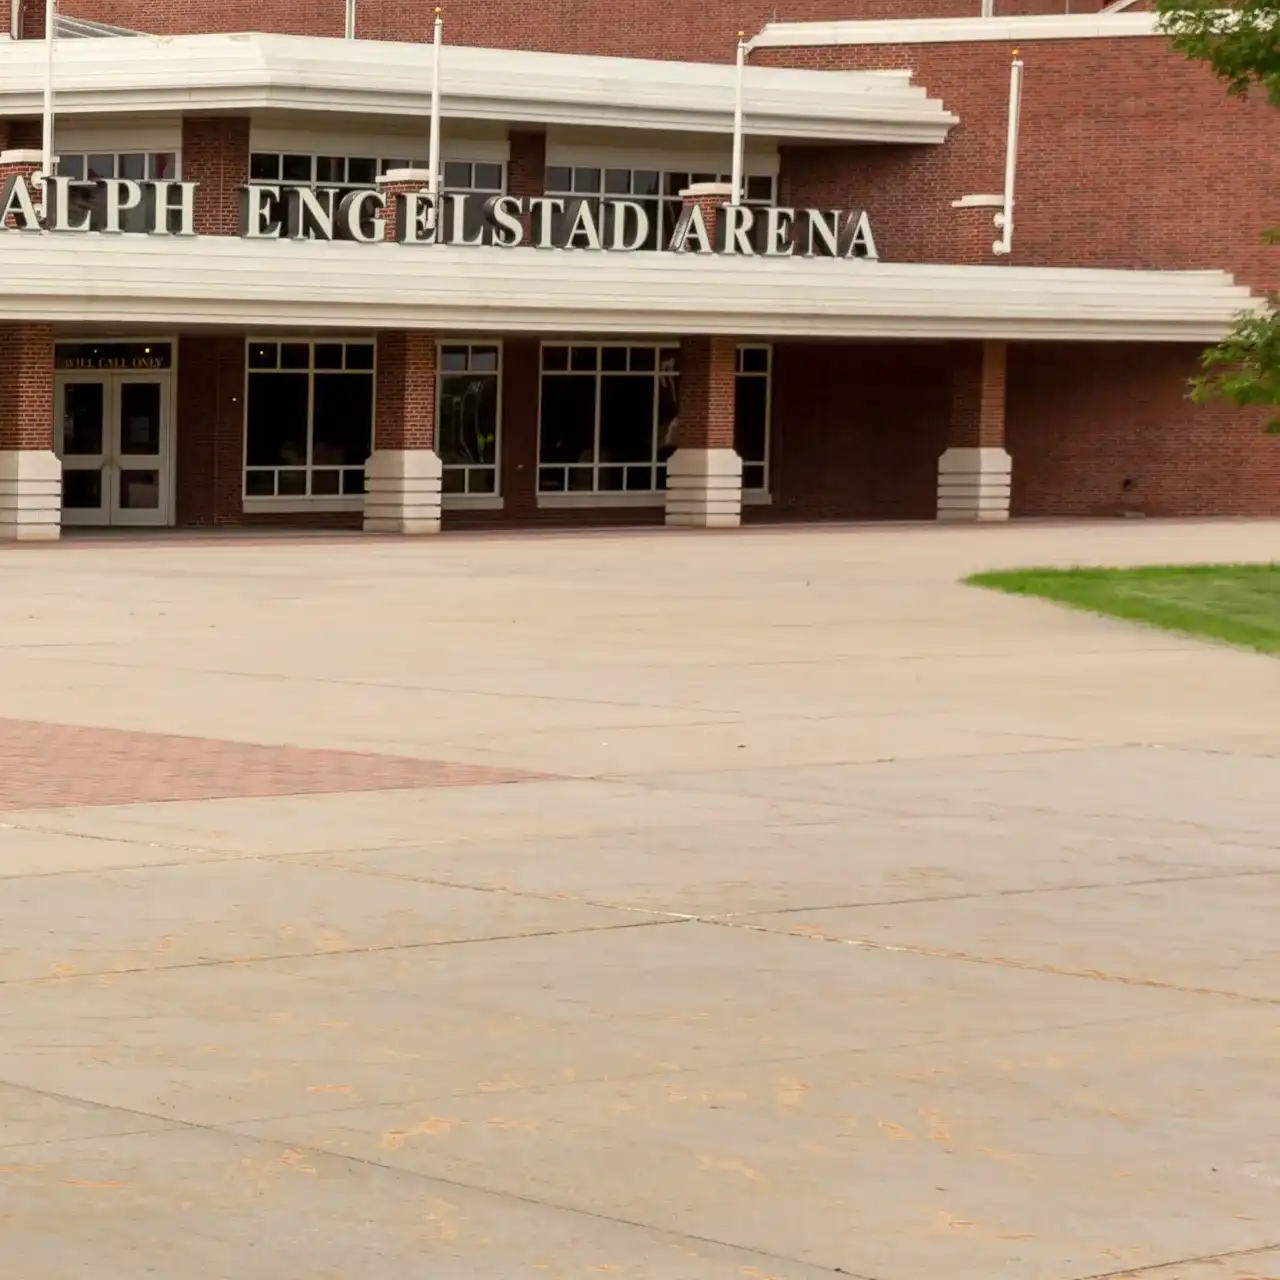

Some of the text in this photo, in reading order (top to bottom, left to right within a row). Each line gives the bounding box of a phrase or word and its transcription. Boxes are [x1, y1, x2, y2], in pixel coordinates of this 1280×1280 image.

[242, 184, 649, 251] ENGELSTAD
[674, 203, 879, 259] ARENA
[65, 356, 163, 368] WILL CALL ONLY
